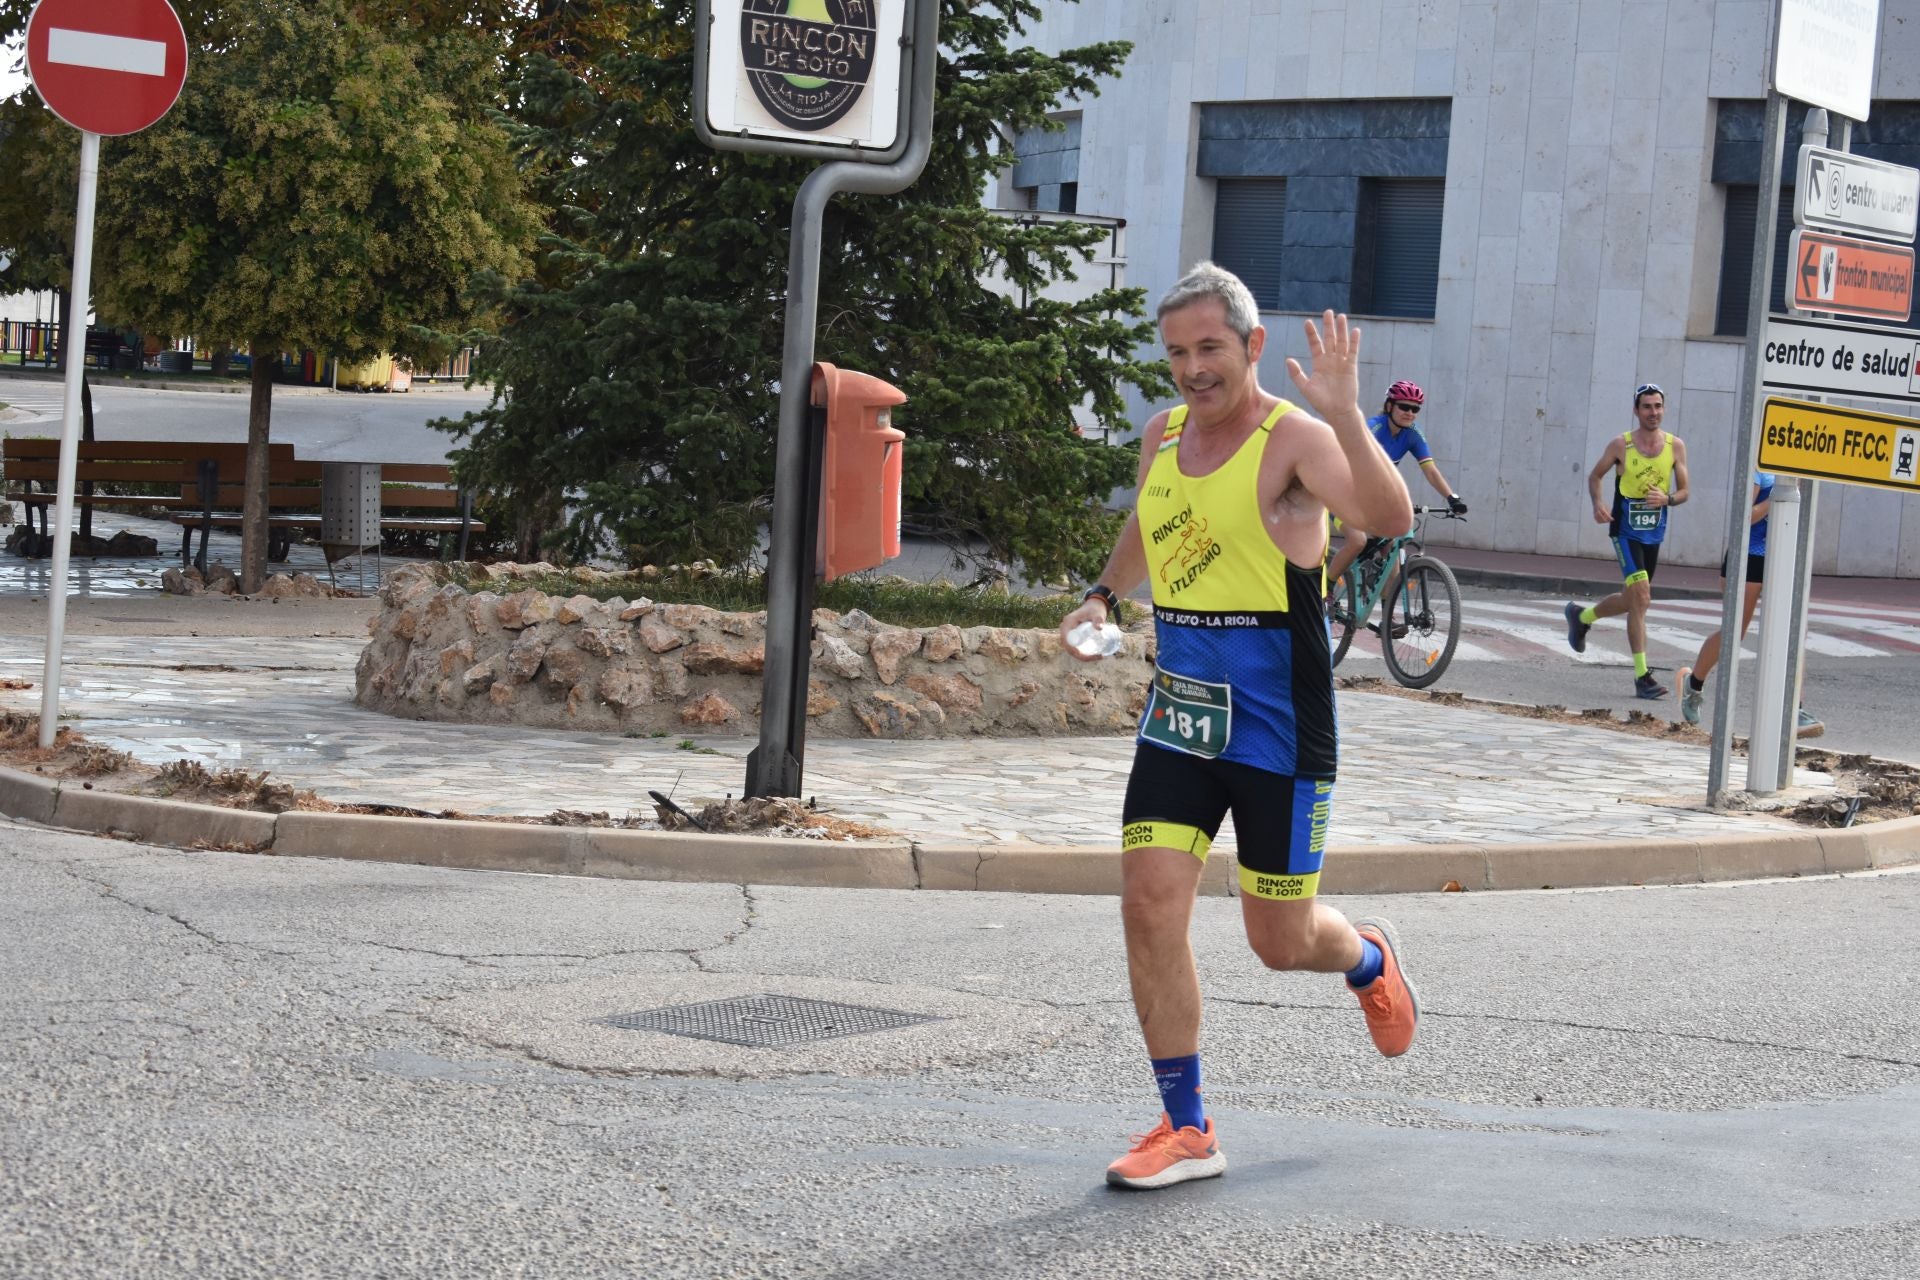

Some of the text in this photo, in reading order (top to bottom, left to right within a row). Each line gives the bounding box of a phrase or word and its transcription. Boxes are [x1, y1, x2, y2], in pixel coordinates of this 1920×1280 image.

[750, 18, 867, 60] RINCÓN
[764, 48, 850, 76] DE SOTO
[780, 83, 832, 105] LA RIOJA
[1846, 181, 1877, 208] centro
[1837, 258, 1909, 299] frontón municipal
[1765, 339, 1910, 378] centro de salud
[1767, 420, 1889, 462] estación FF.CC.
[1634, 514, 1656, 525] 194
[1170, 543, 1221, 598] ATLETISMO
[1224, 615, 1259, 627] RIOJA
[1165, 705, 1211, 743] 181
[1127, 834, 1153, 846] SOTO
[1257, 876, 1304, 888] RINCÓN
[1257, 887, 1302, 896] DE SOTO
